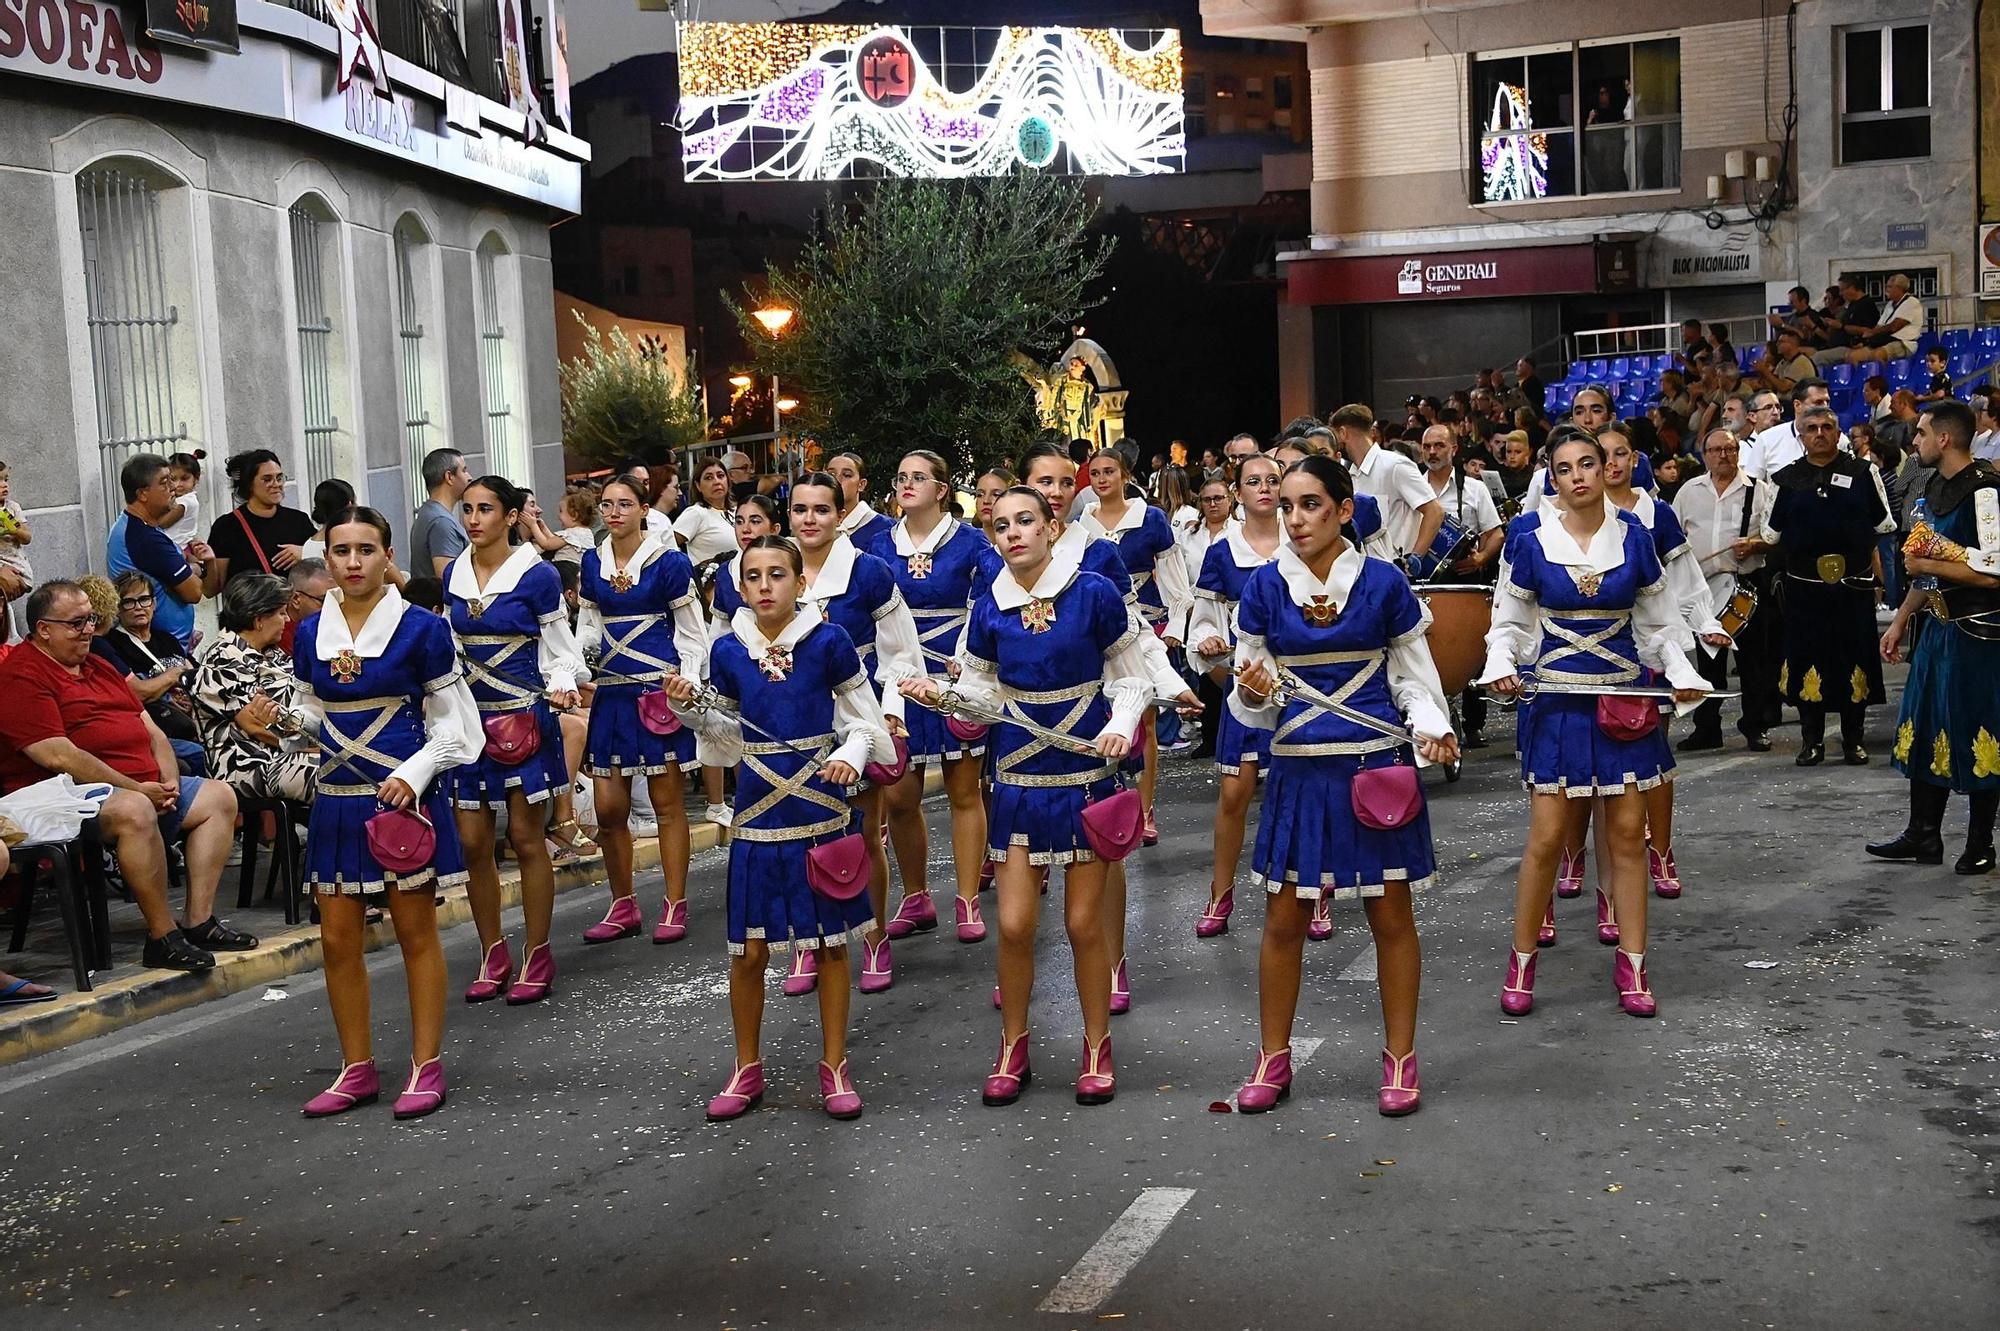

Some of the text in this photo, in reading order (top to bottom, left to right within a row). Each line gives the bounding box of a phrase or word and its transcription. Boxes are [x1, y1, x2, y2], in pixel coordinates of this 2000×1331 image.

[0, 0, 163, 84] SOFAS
[1425, 262, 1497, 282] GENERALI
[1672, 254, 1750, 275] BLOC NACIONALISTA
[1426, 283, 1461, 294] Seguros
